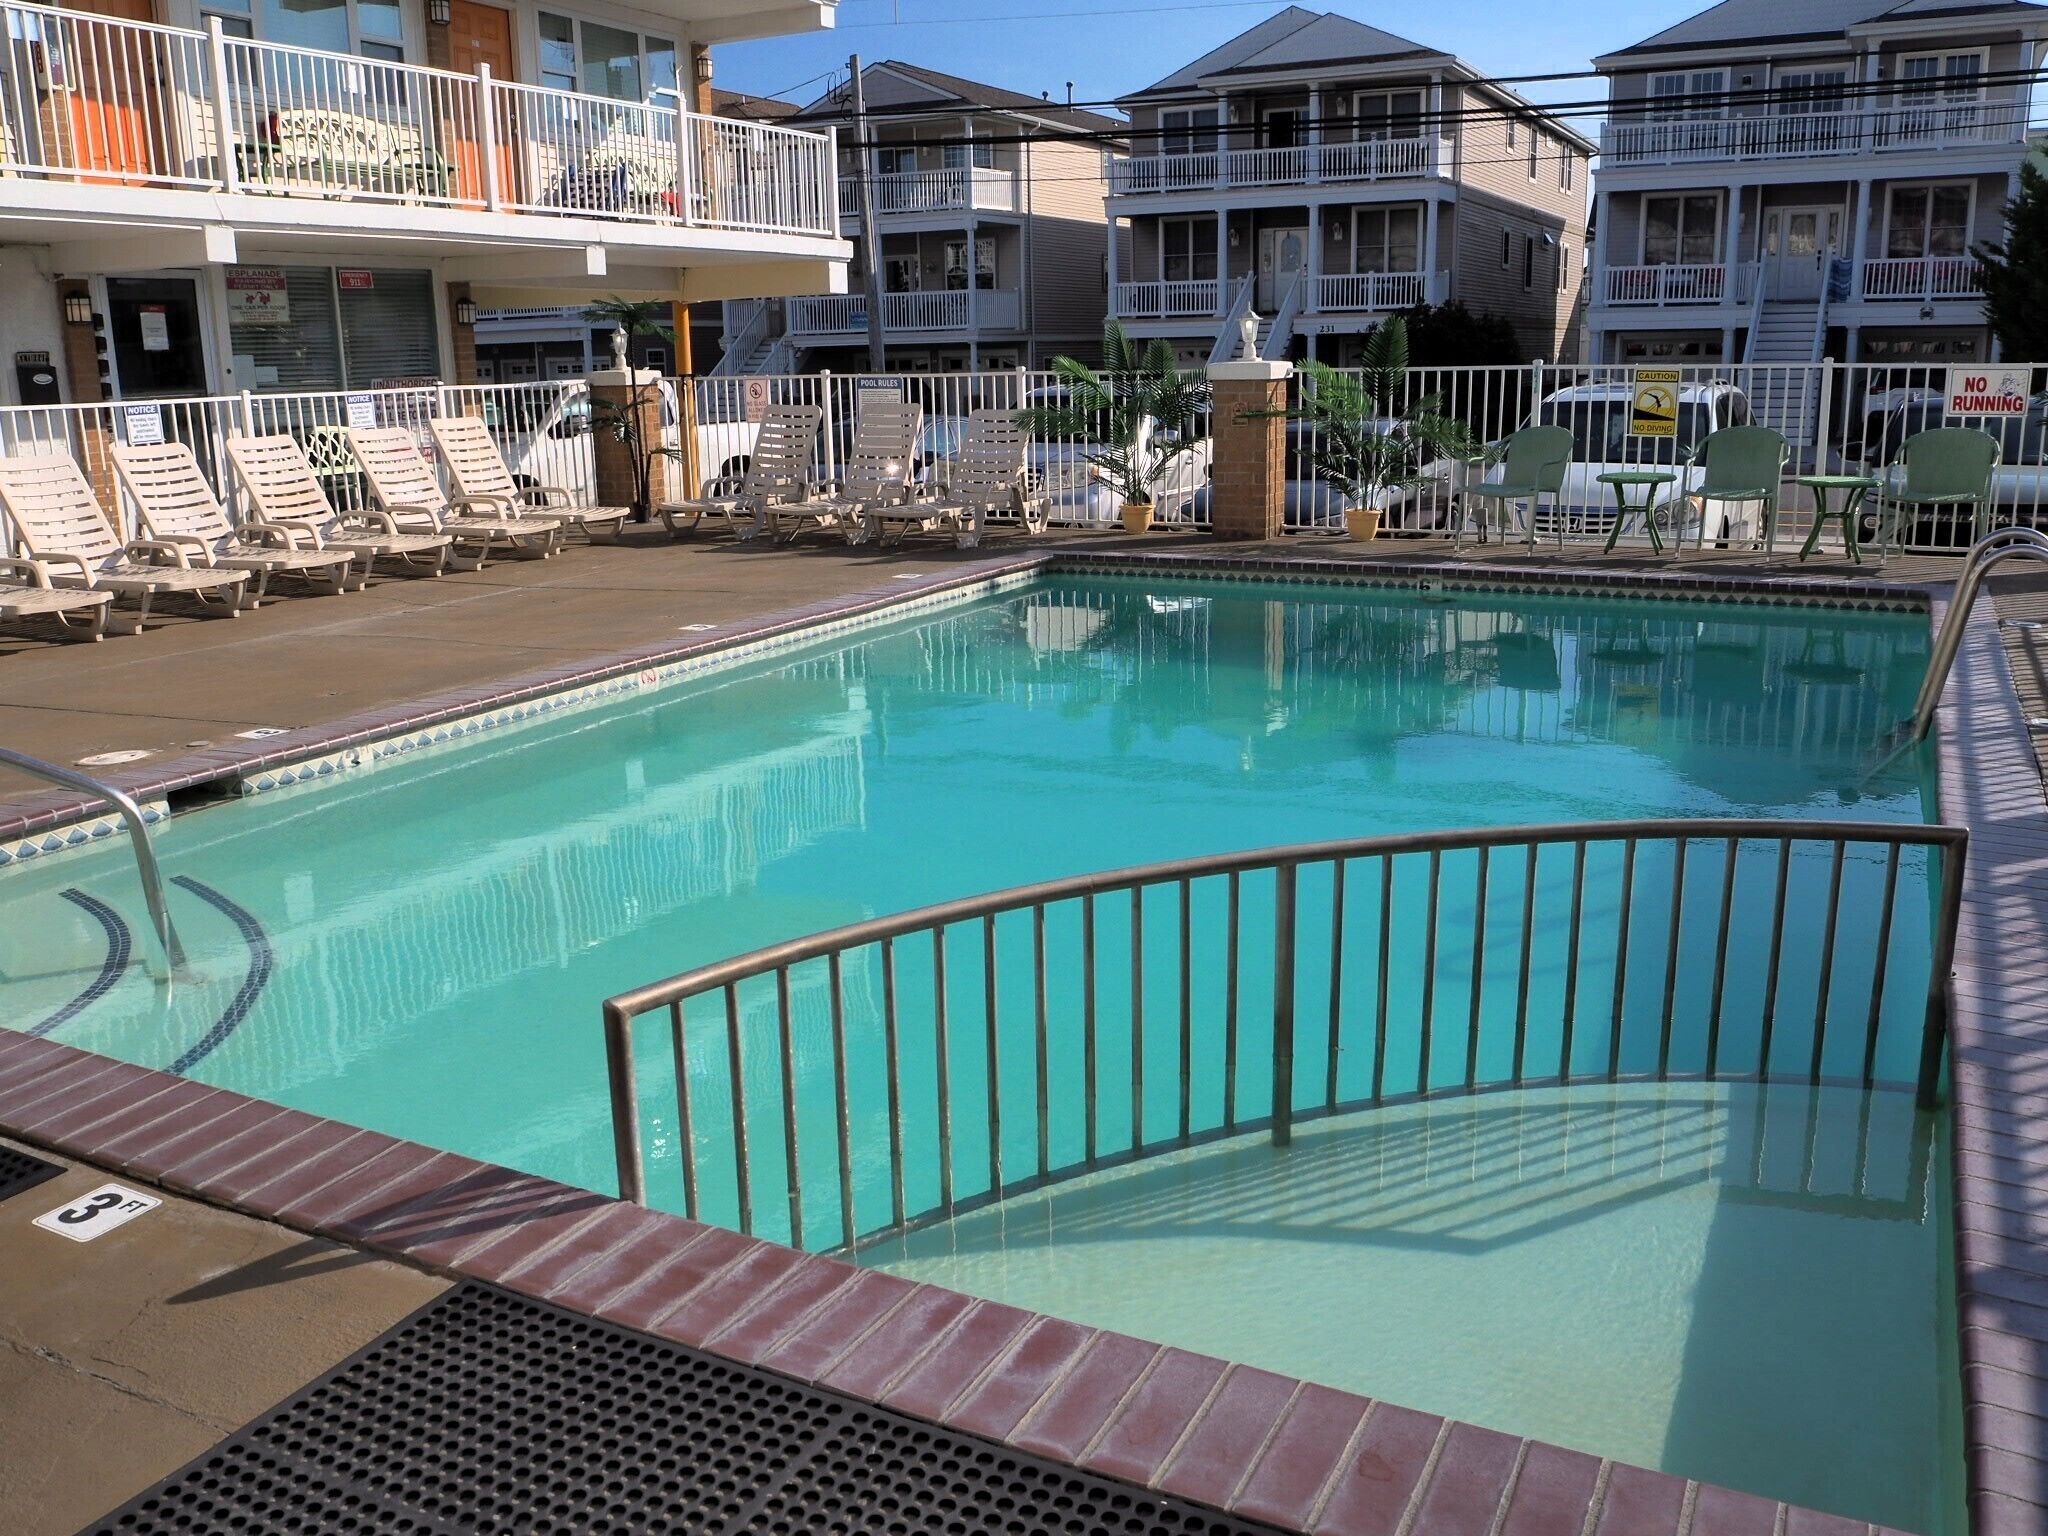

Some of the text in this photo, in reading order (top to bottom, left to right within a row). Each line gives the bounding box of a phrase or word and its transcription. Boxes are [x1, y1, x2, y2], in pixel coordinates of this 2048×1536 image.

[228, 269, 282, 277] ESPLANADE
[349, 278, 361, 286] 911
[1319, 325, 1335, 333] 231
[1638, 372, 1677, 380] CAUTION
[860, 379, 898, 387] POOL RULES
[1964, 376, 1988, 393] NO
[347, 394, 371, 404] NOTICE
[1952, 395, 2024, 412] RUNNING
[127, 406, 157, 415] NOTICE
[1634, 424, 1673, 432] NO DIVING
[58, 1193, 148, 1224] 3 FT
